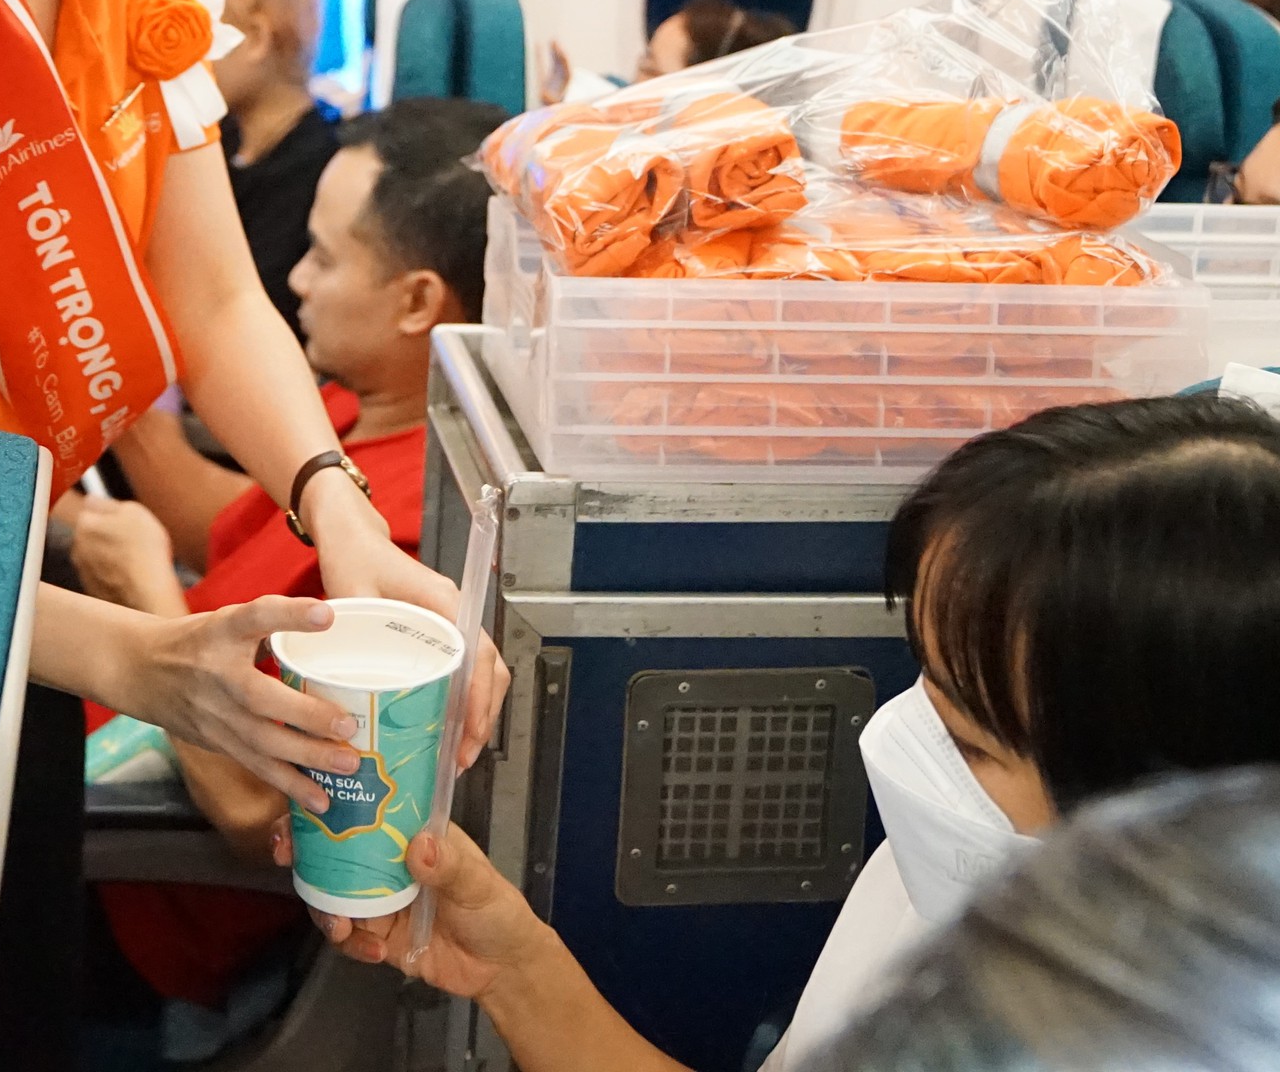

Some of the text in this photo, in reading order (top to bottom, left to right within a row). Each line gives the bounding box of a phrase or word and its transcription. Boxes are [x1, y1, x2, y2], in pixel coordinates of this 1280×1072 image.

[7, 127, 76, 171] Airlines
[18, 180, 76, 271] TÔN
[49, 266, 123, 415] TRỌNG,
[309, 769, 364, 791] TRÀ SỮA
[337, 789, 376, 803] CHÂU
